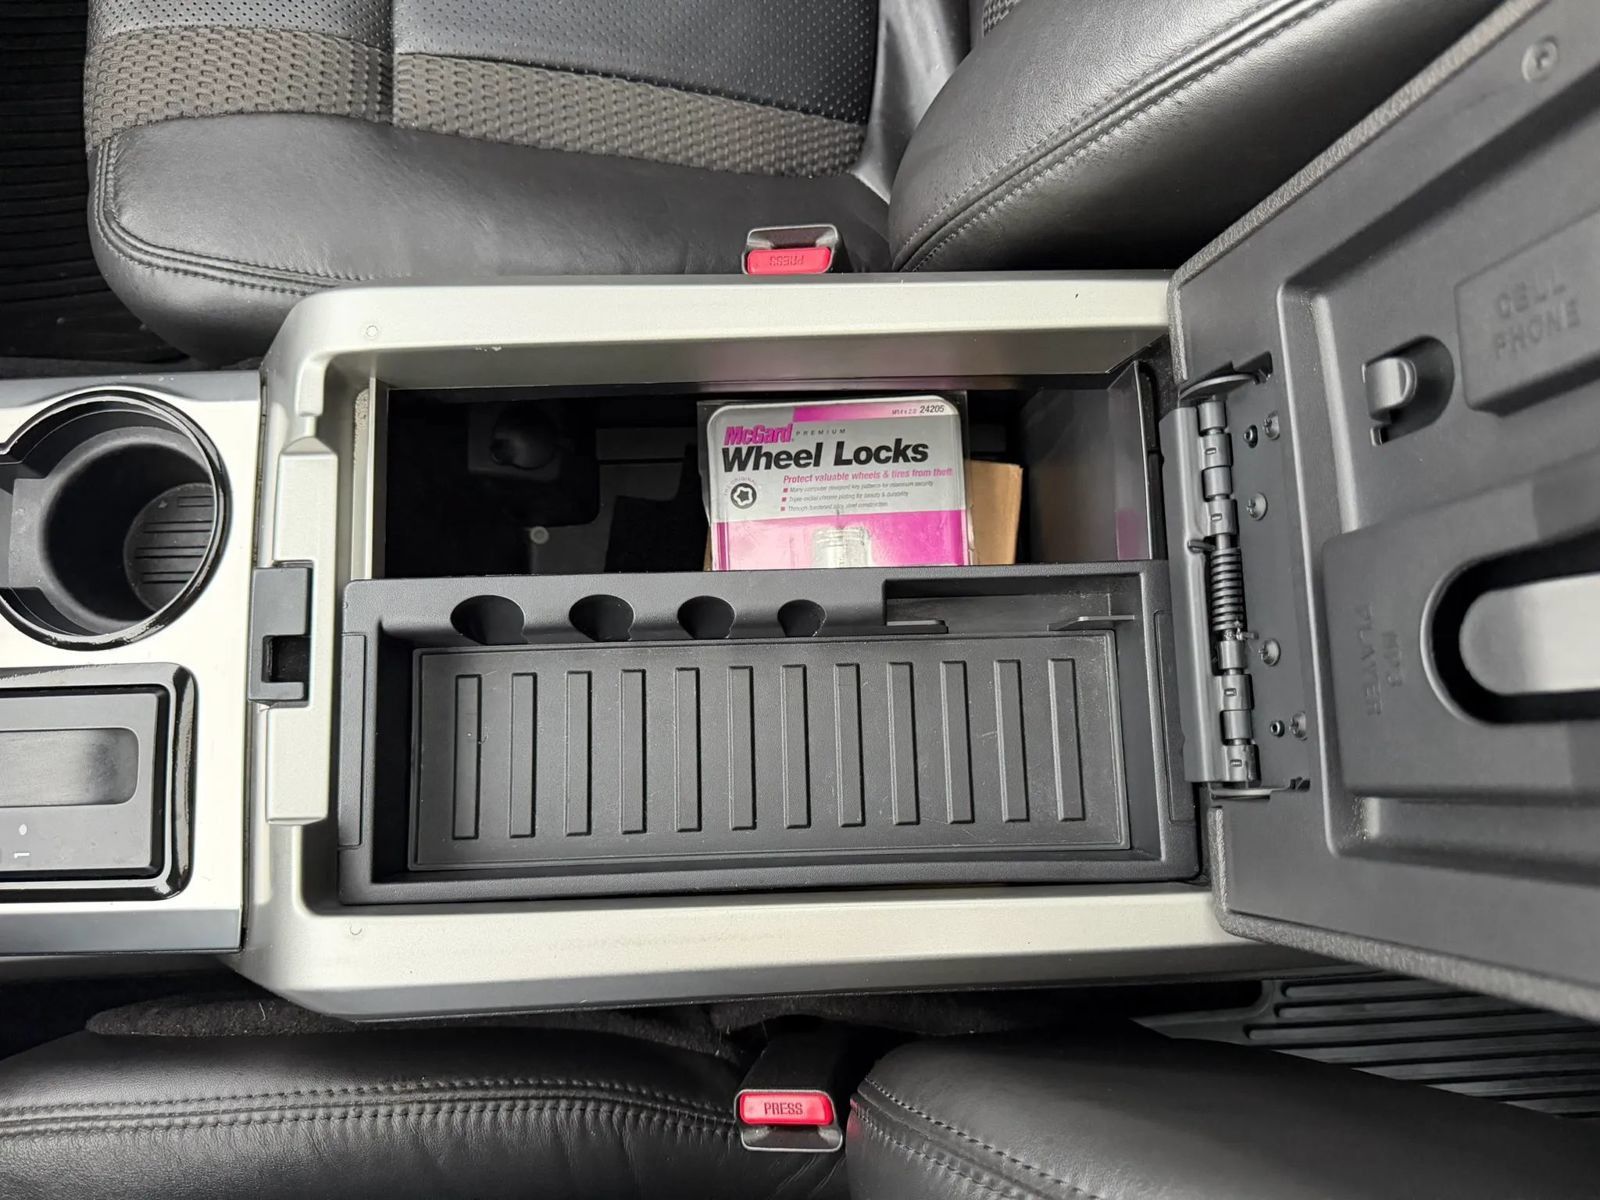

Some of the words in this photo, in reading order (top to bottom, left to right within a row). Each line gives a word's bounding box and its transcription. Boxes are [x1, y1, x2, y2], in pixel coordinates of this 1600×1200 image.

[769, 255, 805, 267] PRESS
[1495, 273, 1567, 319] CELL
[1493, 298, 1581, 361] PHONE
[920, 404, 945, 414] 24205
[723, 423, 793, 446] McGard
[796, 428, 847, 436] PREMIUM
[721, 441, 823, 473] Wheel
[833, 438, 929, 466] Locks
[783, 474, 813, 483] Protect
[815, 472, 850, 482] valuable
[851, 471, 881, 480] wheels
[882, 470, 889, 478] &
[891, 469, 910, 478] tires
[912, 469, 931, 477] from
[763, 1102, 804, 1116] PRESS
